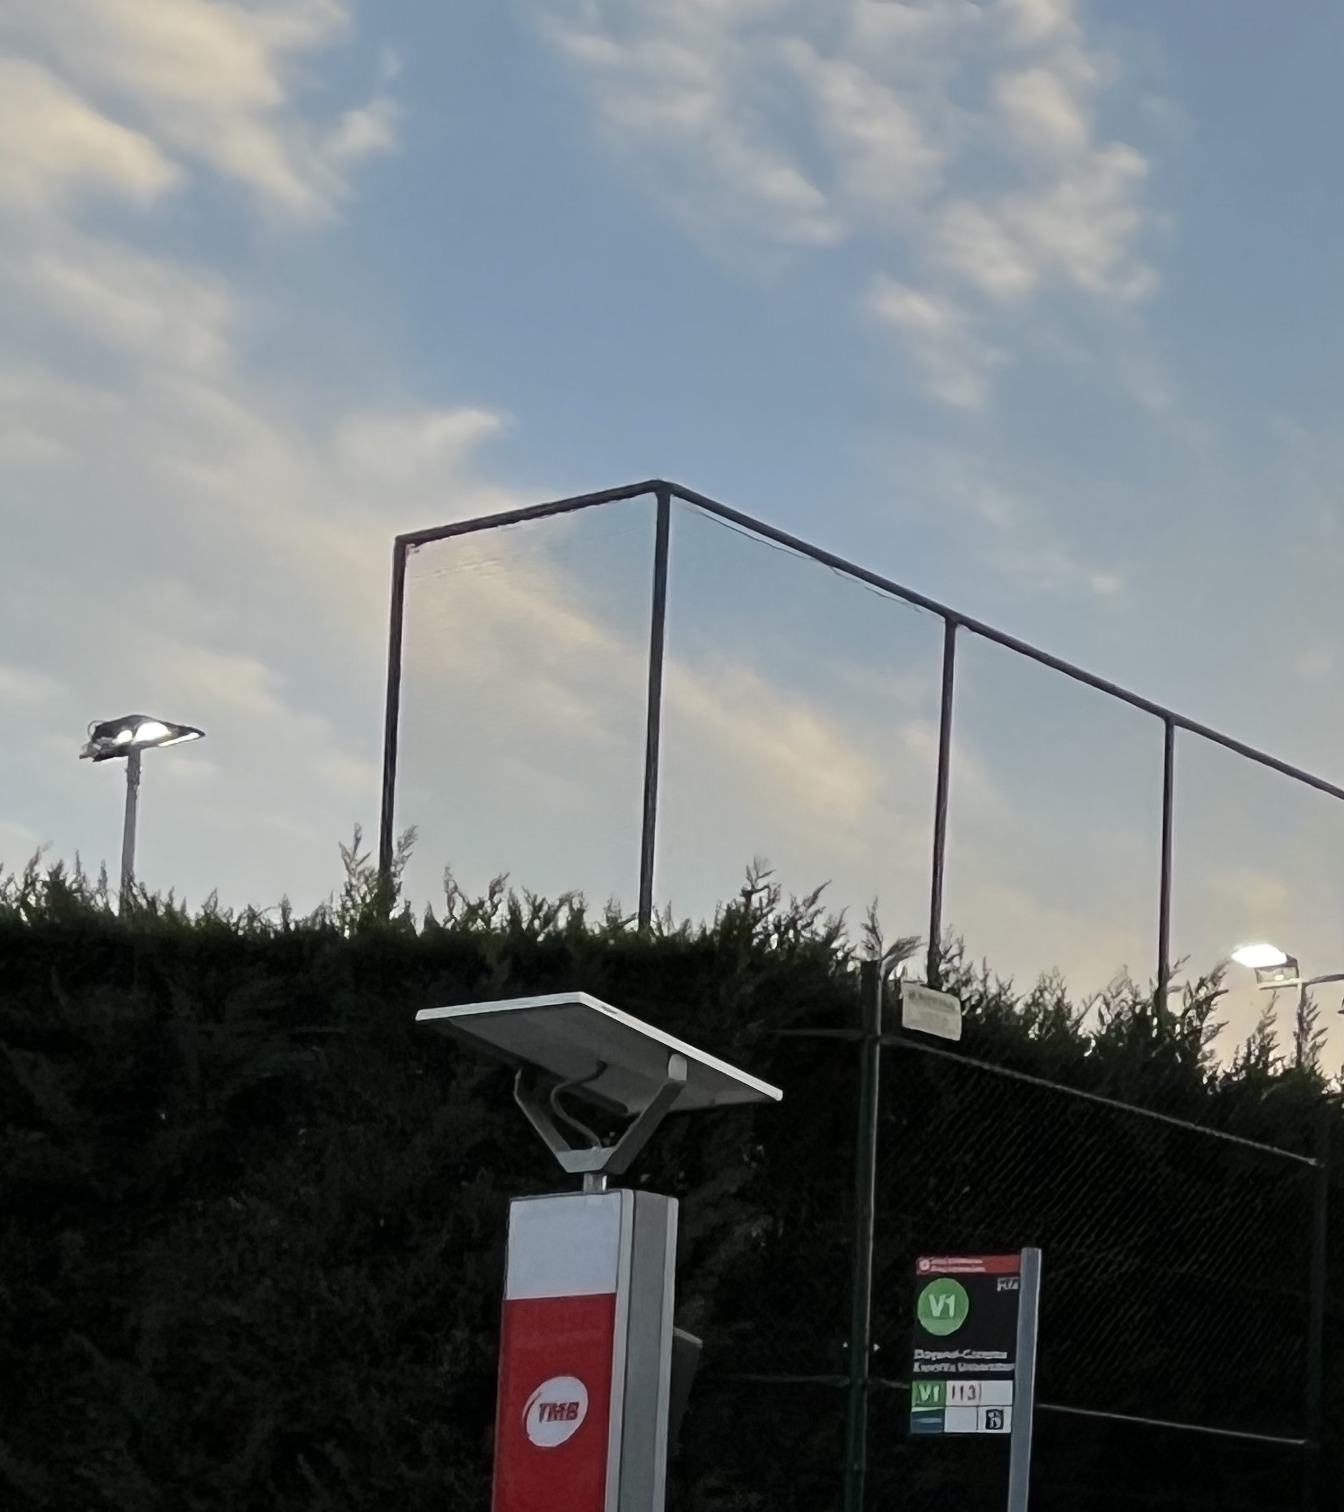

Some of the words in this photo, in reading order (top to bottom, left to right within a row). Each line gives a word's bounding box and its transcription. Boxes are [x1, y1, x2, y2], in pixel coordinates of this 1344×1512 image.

[928, 1294, 956, 1318] V1
[951, 1384, 976, 1401] 113
[538, 1402, 580, 1423] TMB
